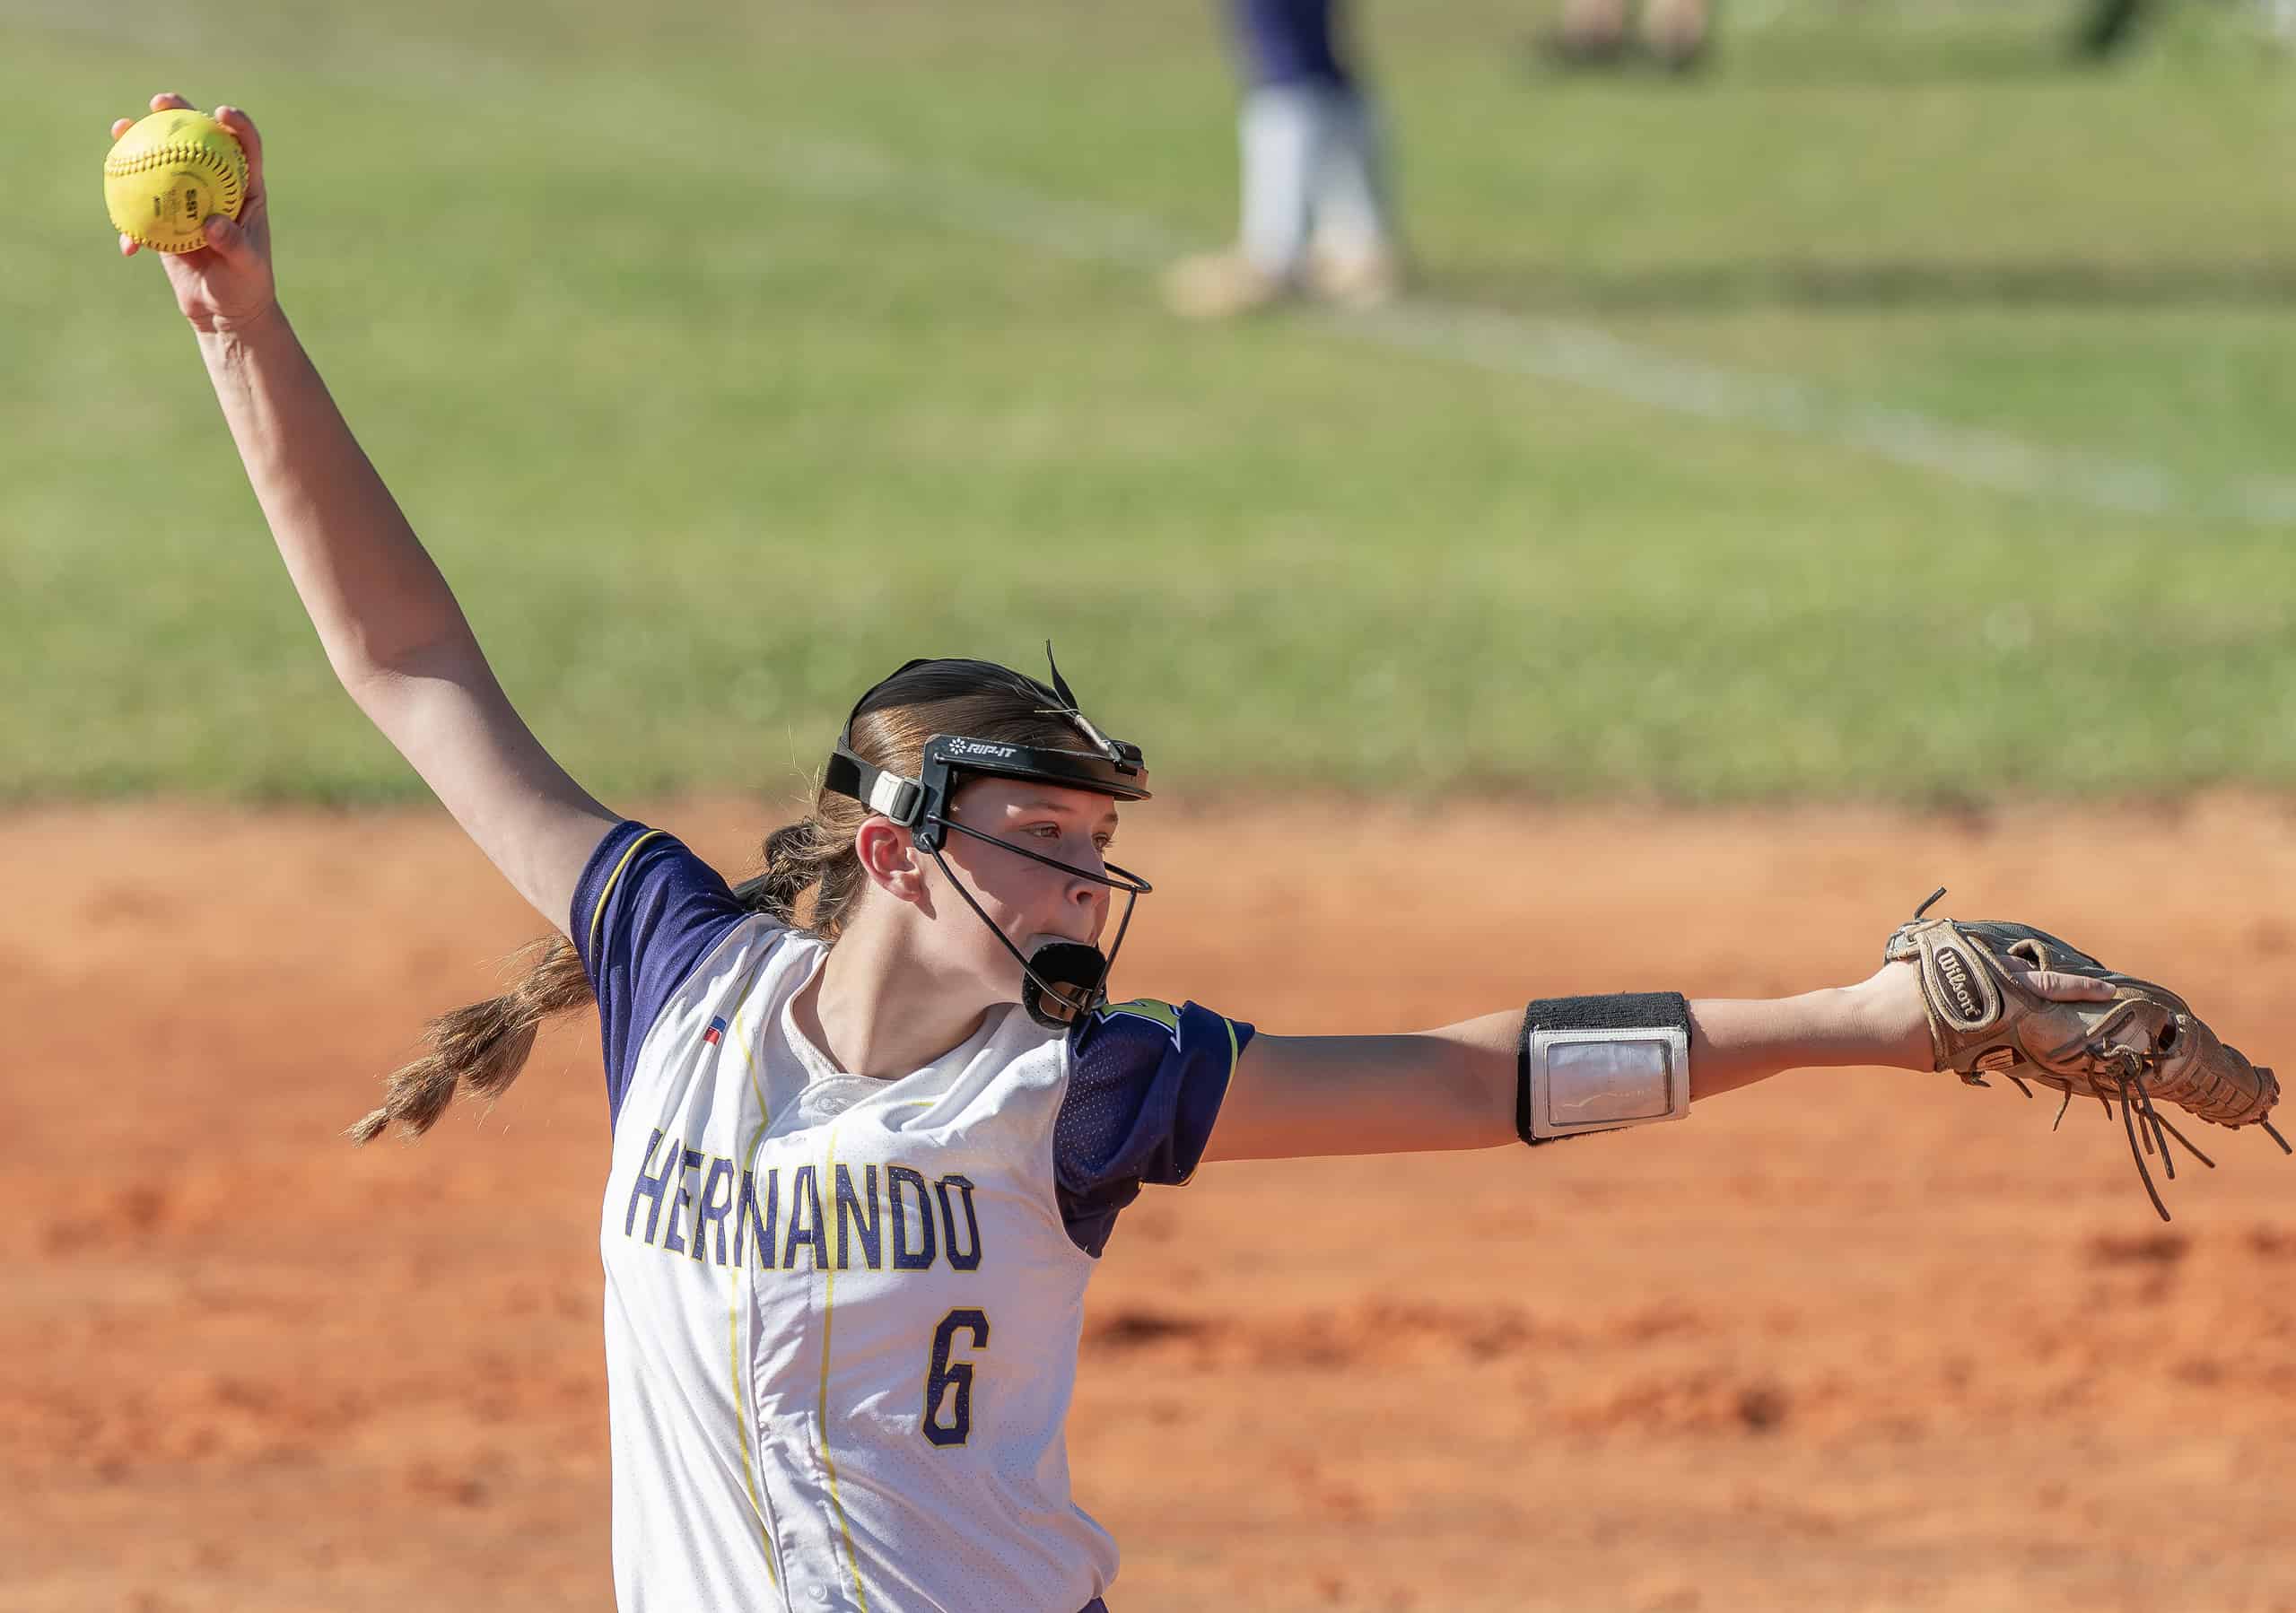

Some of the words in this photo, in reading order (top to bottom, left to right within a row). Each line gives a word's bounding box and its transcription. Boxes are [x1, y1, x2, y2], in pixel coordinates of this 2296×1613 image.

[966, 743, 1017, 758] RIP-IT
[1938, 951, 1977, 1016] Wilson
[624, 1128, 982, 1271] HERNANDO
[921, 1306, 991, 1449] 6
